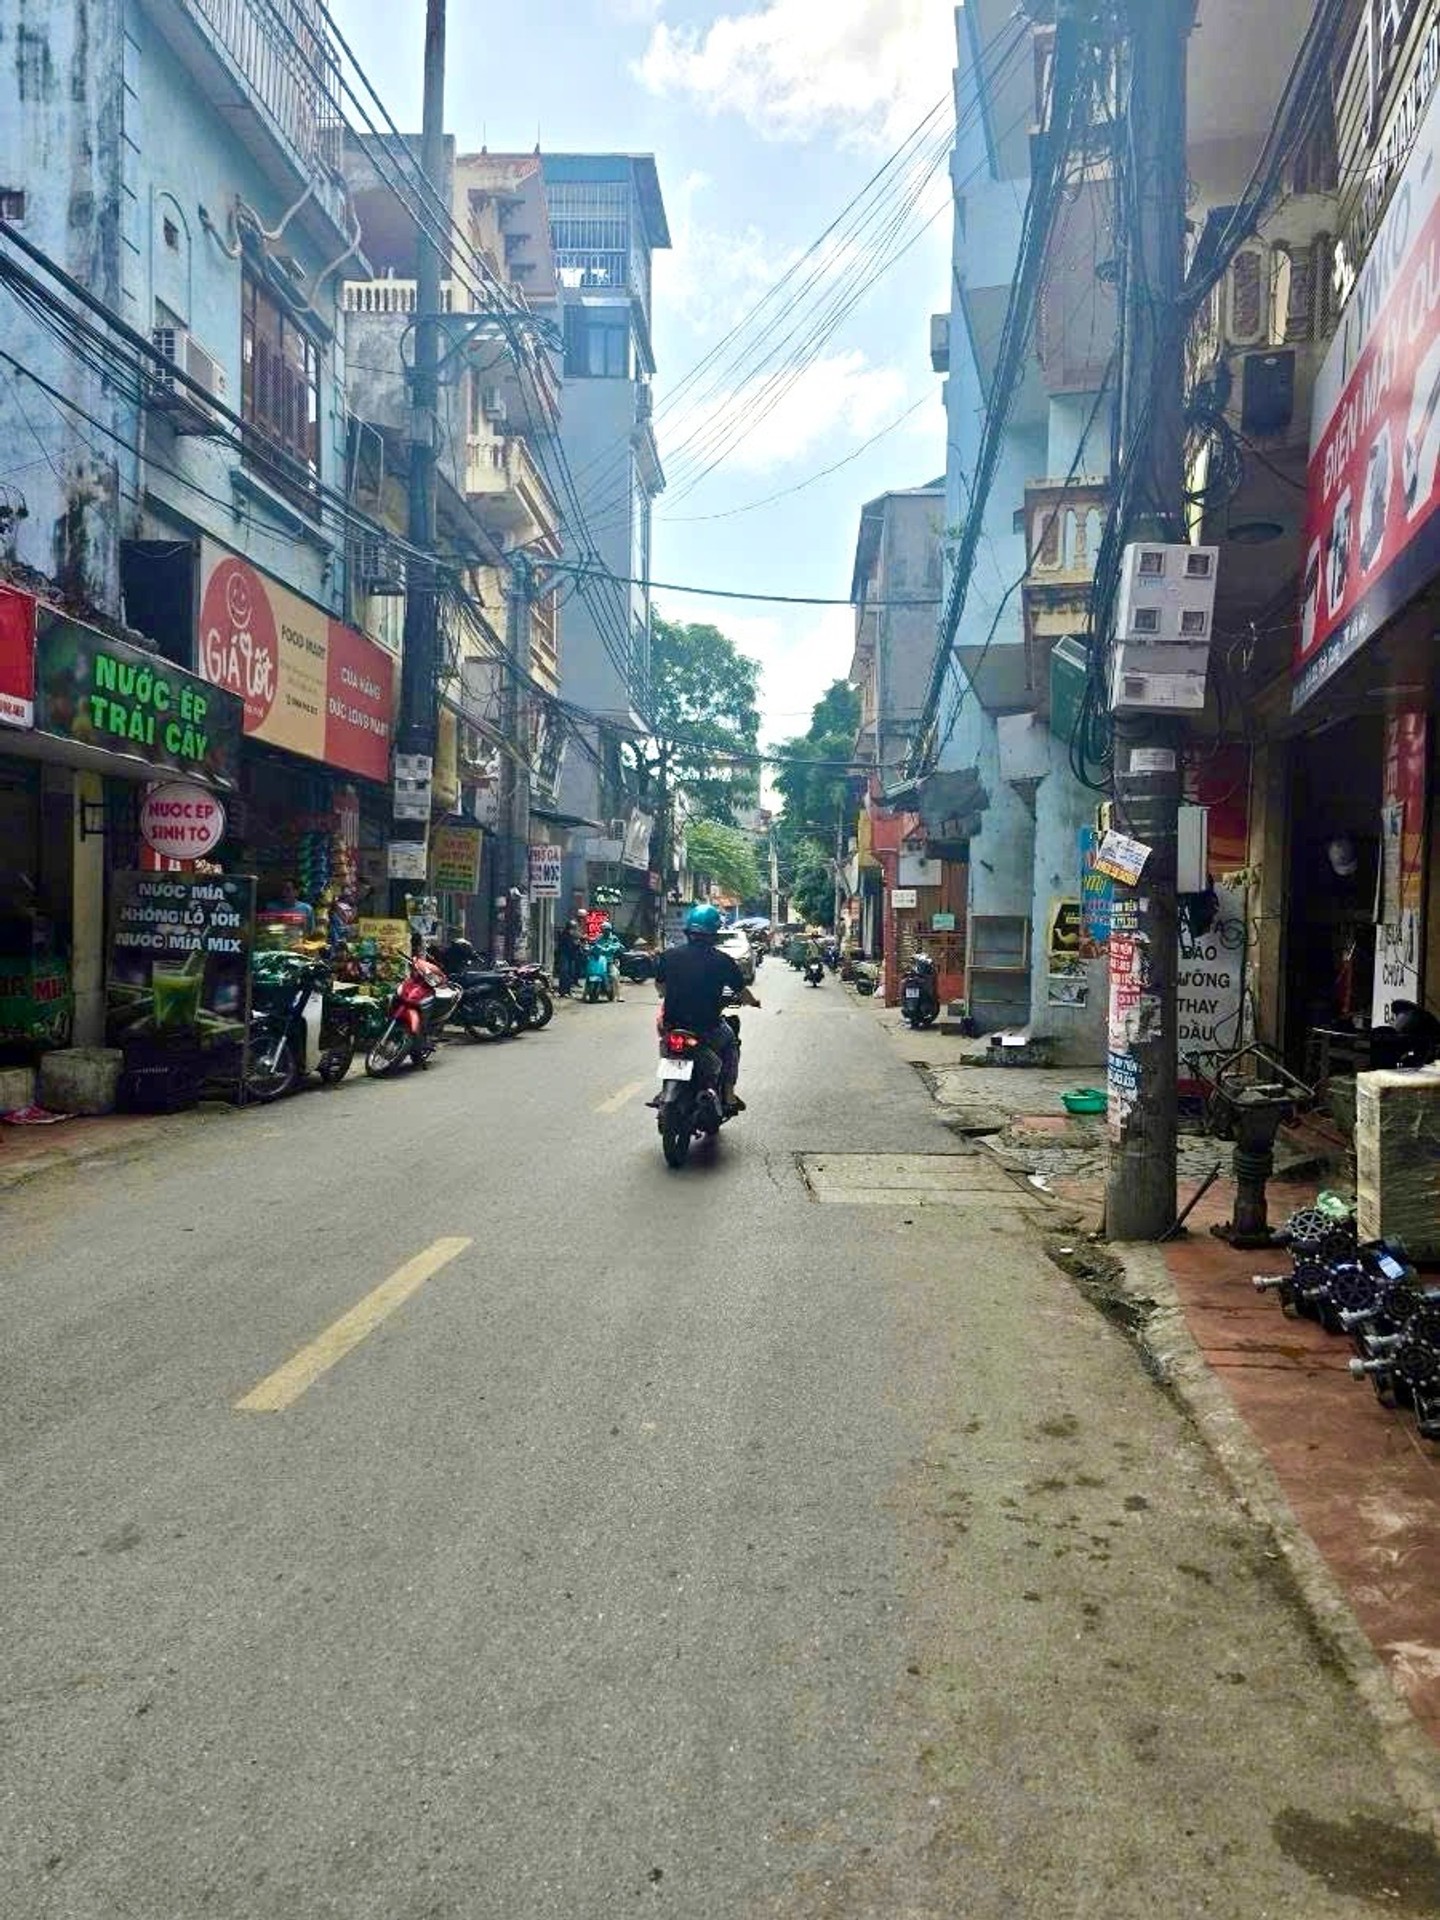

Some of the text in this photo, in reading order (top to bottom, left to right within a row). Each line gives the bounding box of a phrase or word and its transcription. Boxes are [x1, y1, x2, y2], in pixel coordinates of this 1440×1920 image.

[281, 624, 304, 648] FOOD
[96, 654, 207, 724] NƯỚC ÉP
[90, 694, 208, 762] TRÁI CÂY
[152, 825, 185, 841] SINH
[191, 883, 225, 901] MÍA
[169, 934, 202, 951] MÍA
[207, 937, 243, 953] MIX
[1176, 998, 1218, 1013] THAY
[1178, 1019, 1214, 1041] DẦU
